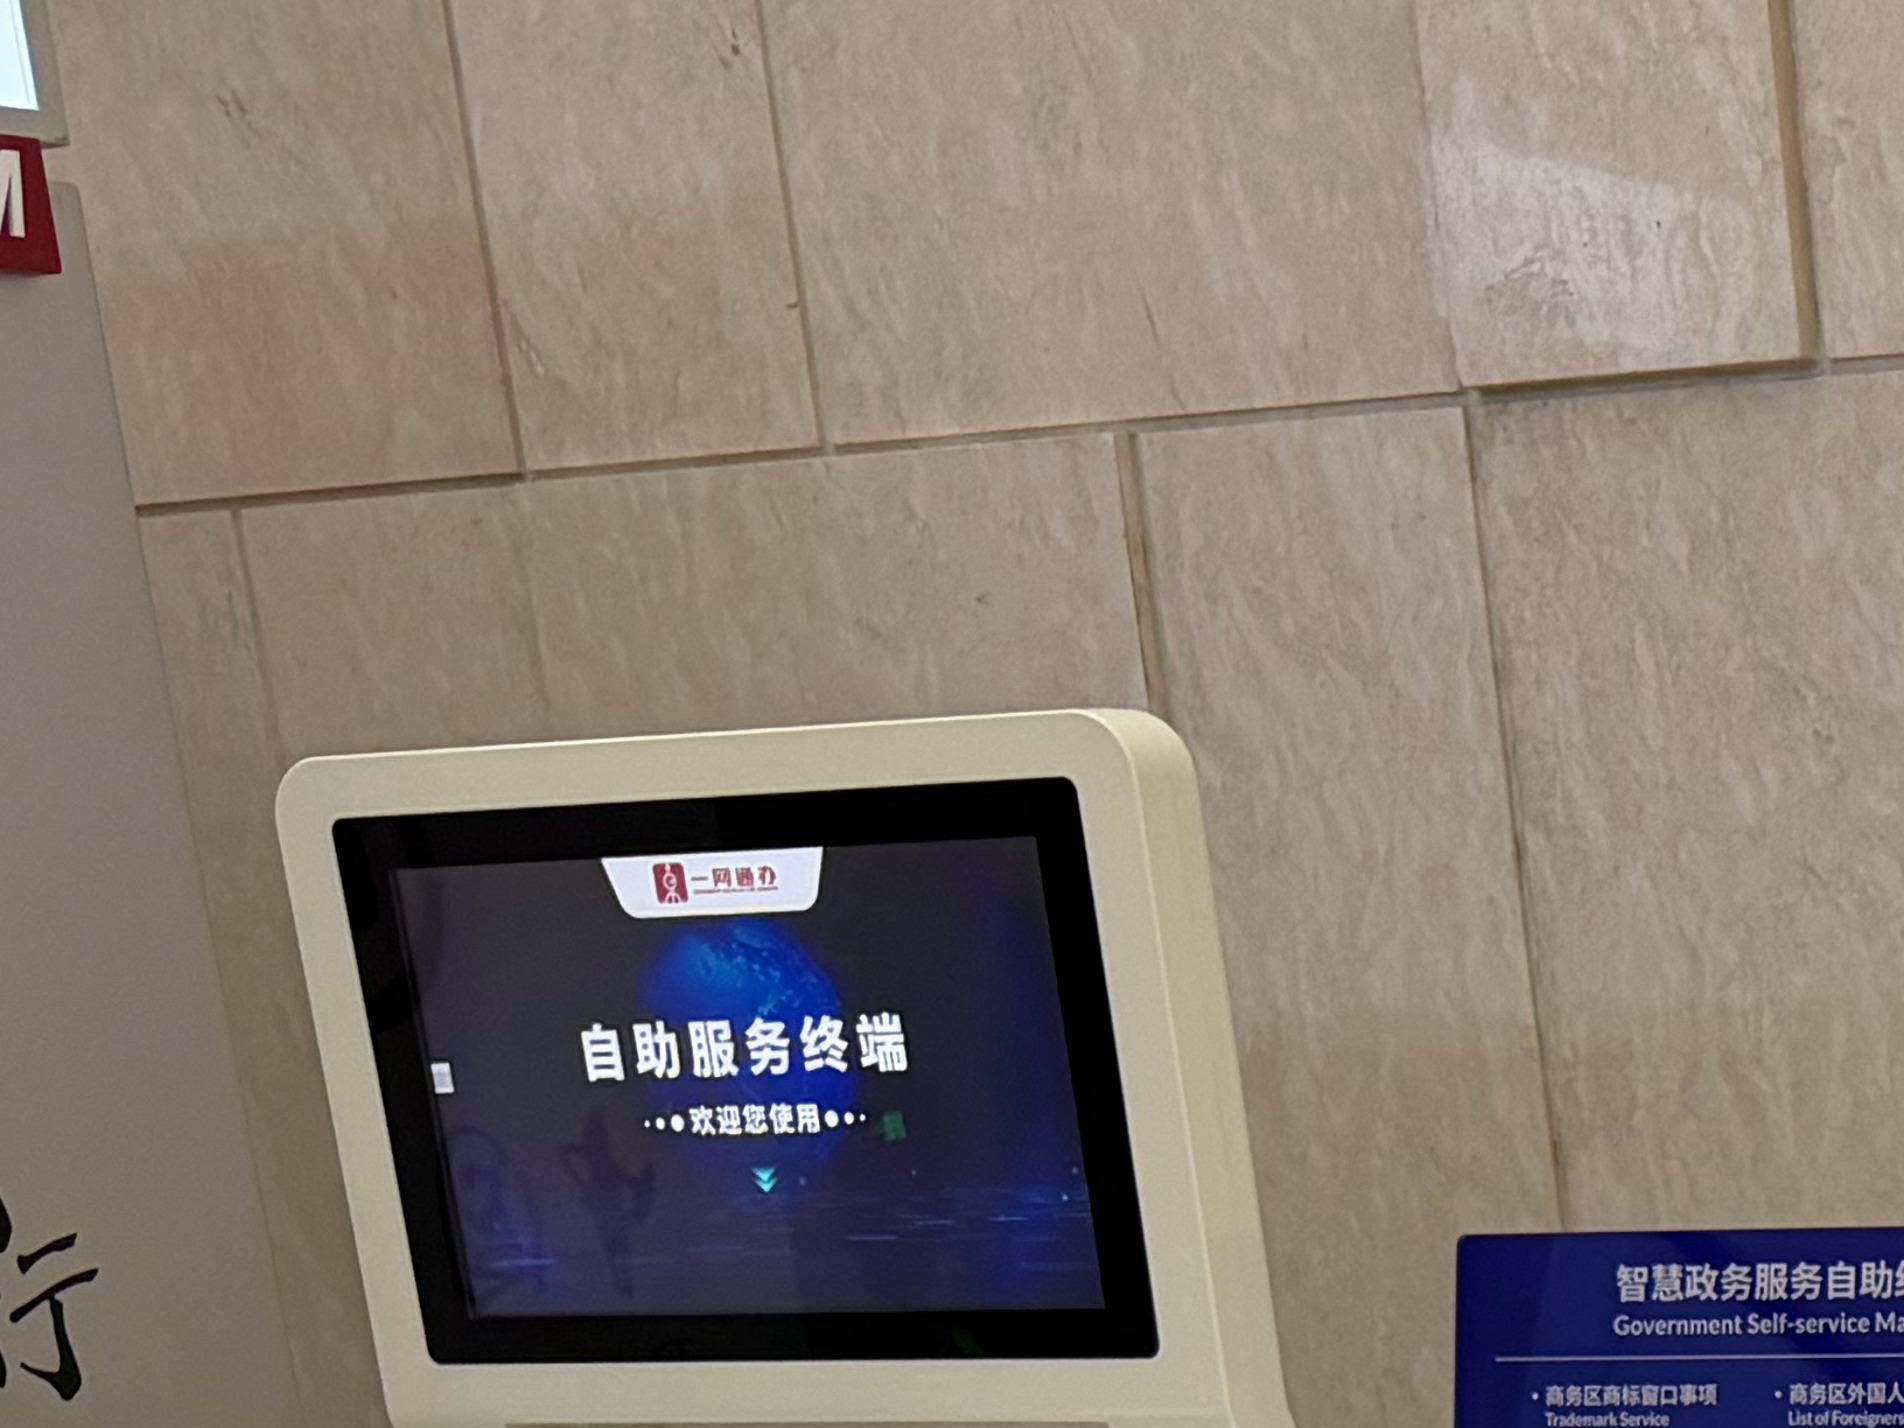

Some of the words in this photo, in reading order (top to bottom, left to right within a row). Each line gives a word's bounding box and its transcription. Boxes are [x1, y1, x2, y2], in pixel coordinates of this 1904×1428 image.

[691, 865, 777, 887] 一网通办
[580, 1011, 909, 1083] 自助服务终端
[689, 1104, 822, 1136] 欢迎您使用
[1612, 1312, 1744, 1338] Government
[1747, 1309, 1871, 1336] Self-service
[1544, 1382, 1718, 1407] 商务区商标窗口事项
[1545, 1411, 1618, 1428] Trademark
[1620, 1411, 1670, 1428] Service
[1787, 1409, 1812, 1427] List
[1814, 1409, 1829, 1426] of
